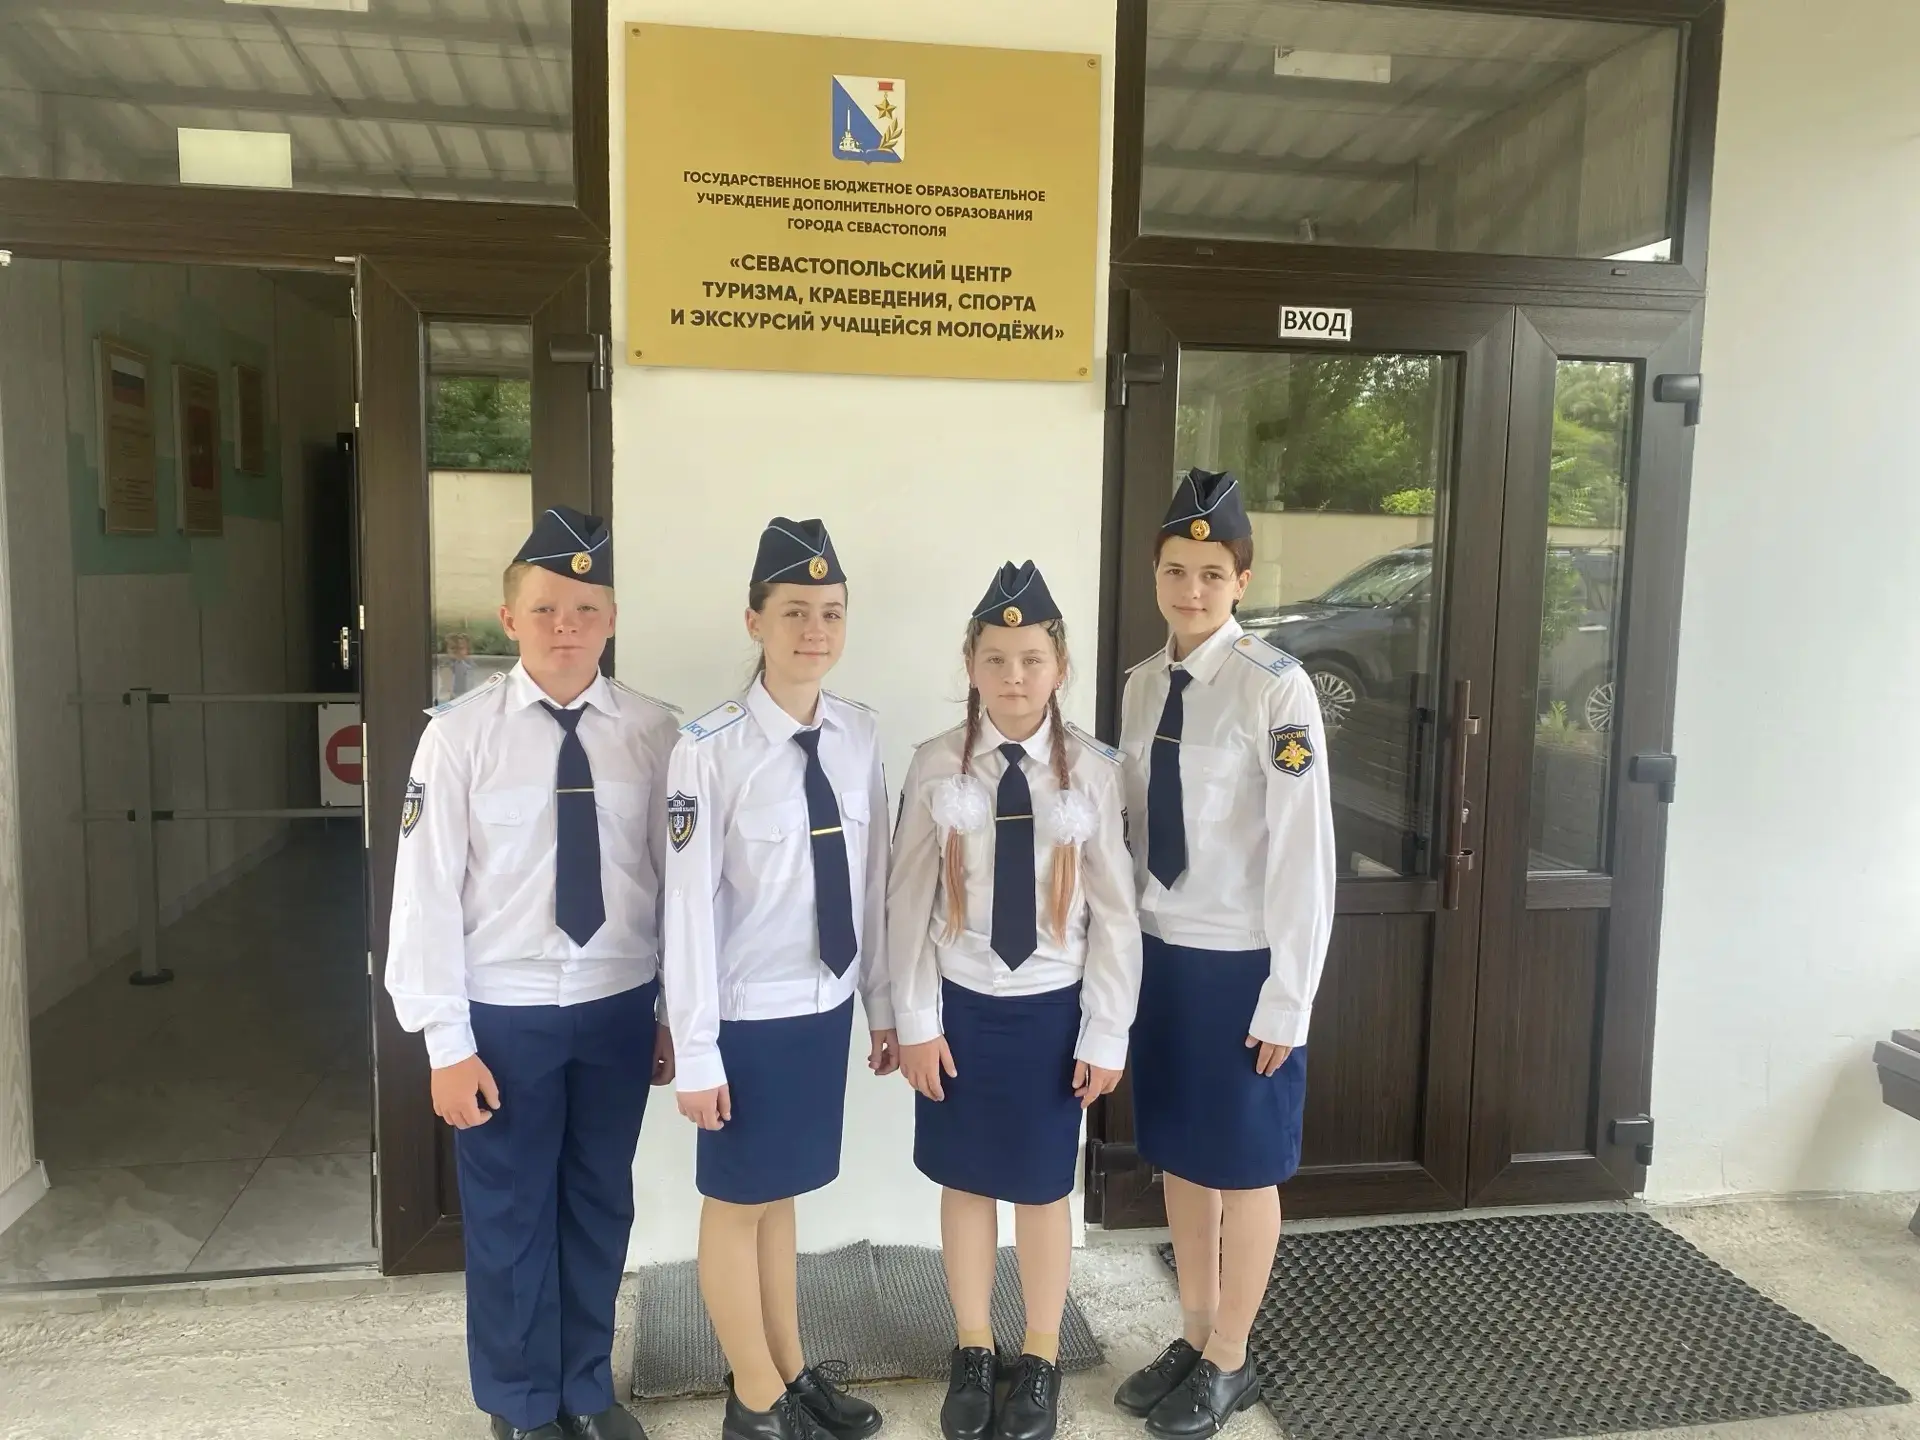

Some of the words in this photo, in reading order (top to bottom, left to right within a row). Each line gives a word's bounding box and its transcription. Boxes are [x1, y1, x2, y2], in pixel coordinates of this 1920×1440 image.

[683, 170, 821, 191] ГОСУДАРСТВЕННОЕ
[823, 178, 913, 196] БЮДЖЕТНОЕ
[915, 184, 1046, 203] ОБРАЗОВАТЕЛЬНОЕ
[696, 191, 791, 209] УЧРЕЖДЕНИЕ
[792, 197, 933, 217] ДОПОЛНИТЕЛЬНОГО
[934, 205, 1033, 222] ОБРАЗОВАНИЯ
[787, 217, 845, 234] ГОРОДА
[846, 220, 947, 238] СЕВАСТОПОЛЯ
[729, 253, 946, 281] «СЕВАСТОПОЛЬСКИЙ
[950, 264, 1013, 284] ЦЕНТР
[701, 280, 804, 306] ТУРИЗМА,
[809, 286, 953, 313] КРАЕВЕДЕНИЯ,
[957, 292, 1037, 313] СПОРТА
[670, 308, 685, 326] И
[689, 309, 815, 332] ЭКСКУРСИЙ
[819, 314, 932, 337] УЧАЩЕЙСЯ
[936, 319, 1065, 342] МОЛОДЁЖИ»
[1284, 310, 1347, 337] ВХОД
[1275, 730, 1306, 742] РОССИЯ
